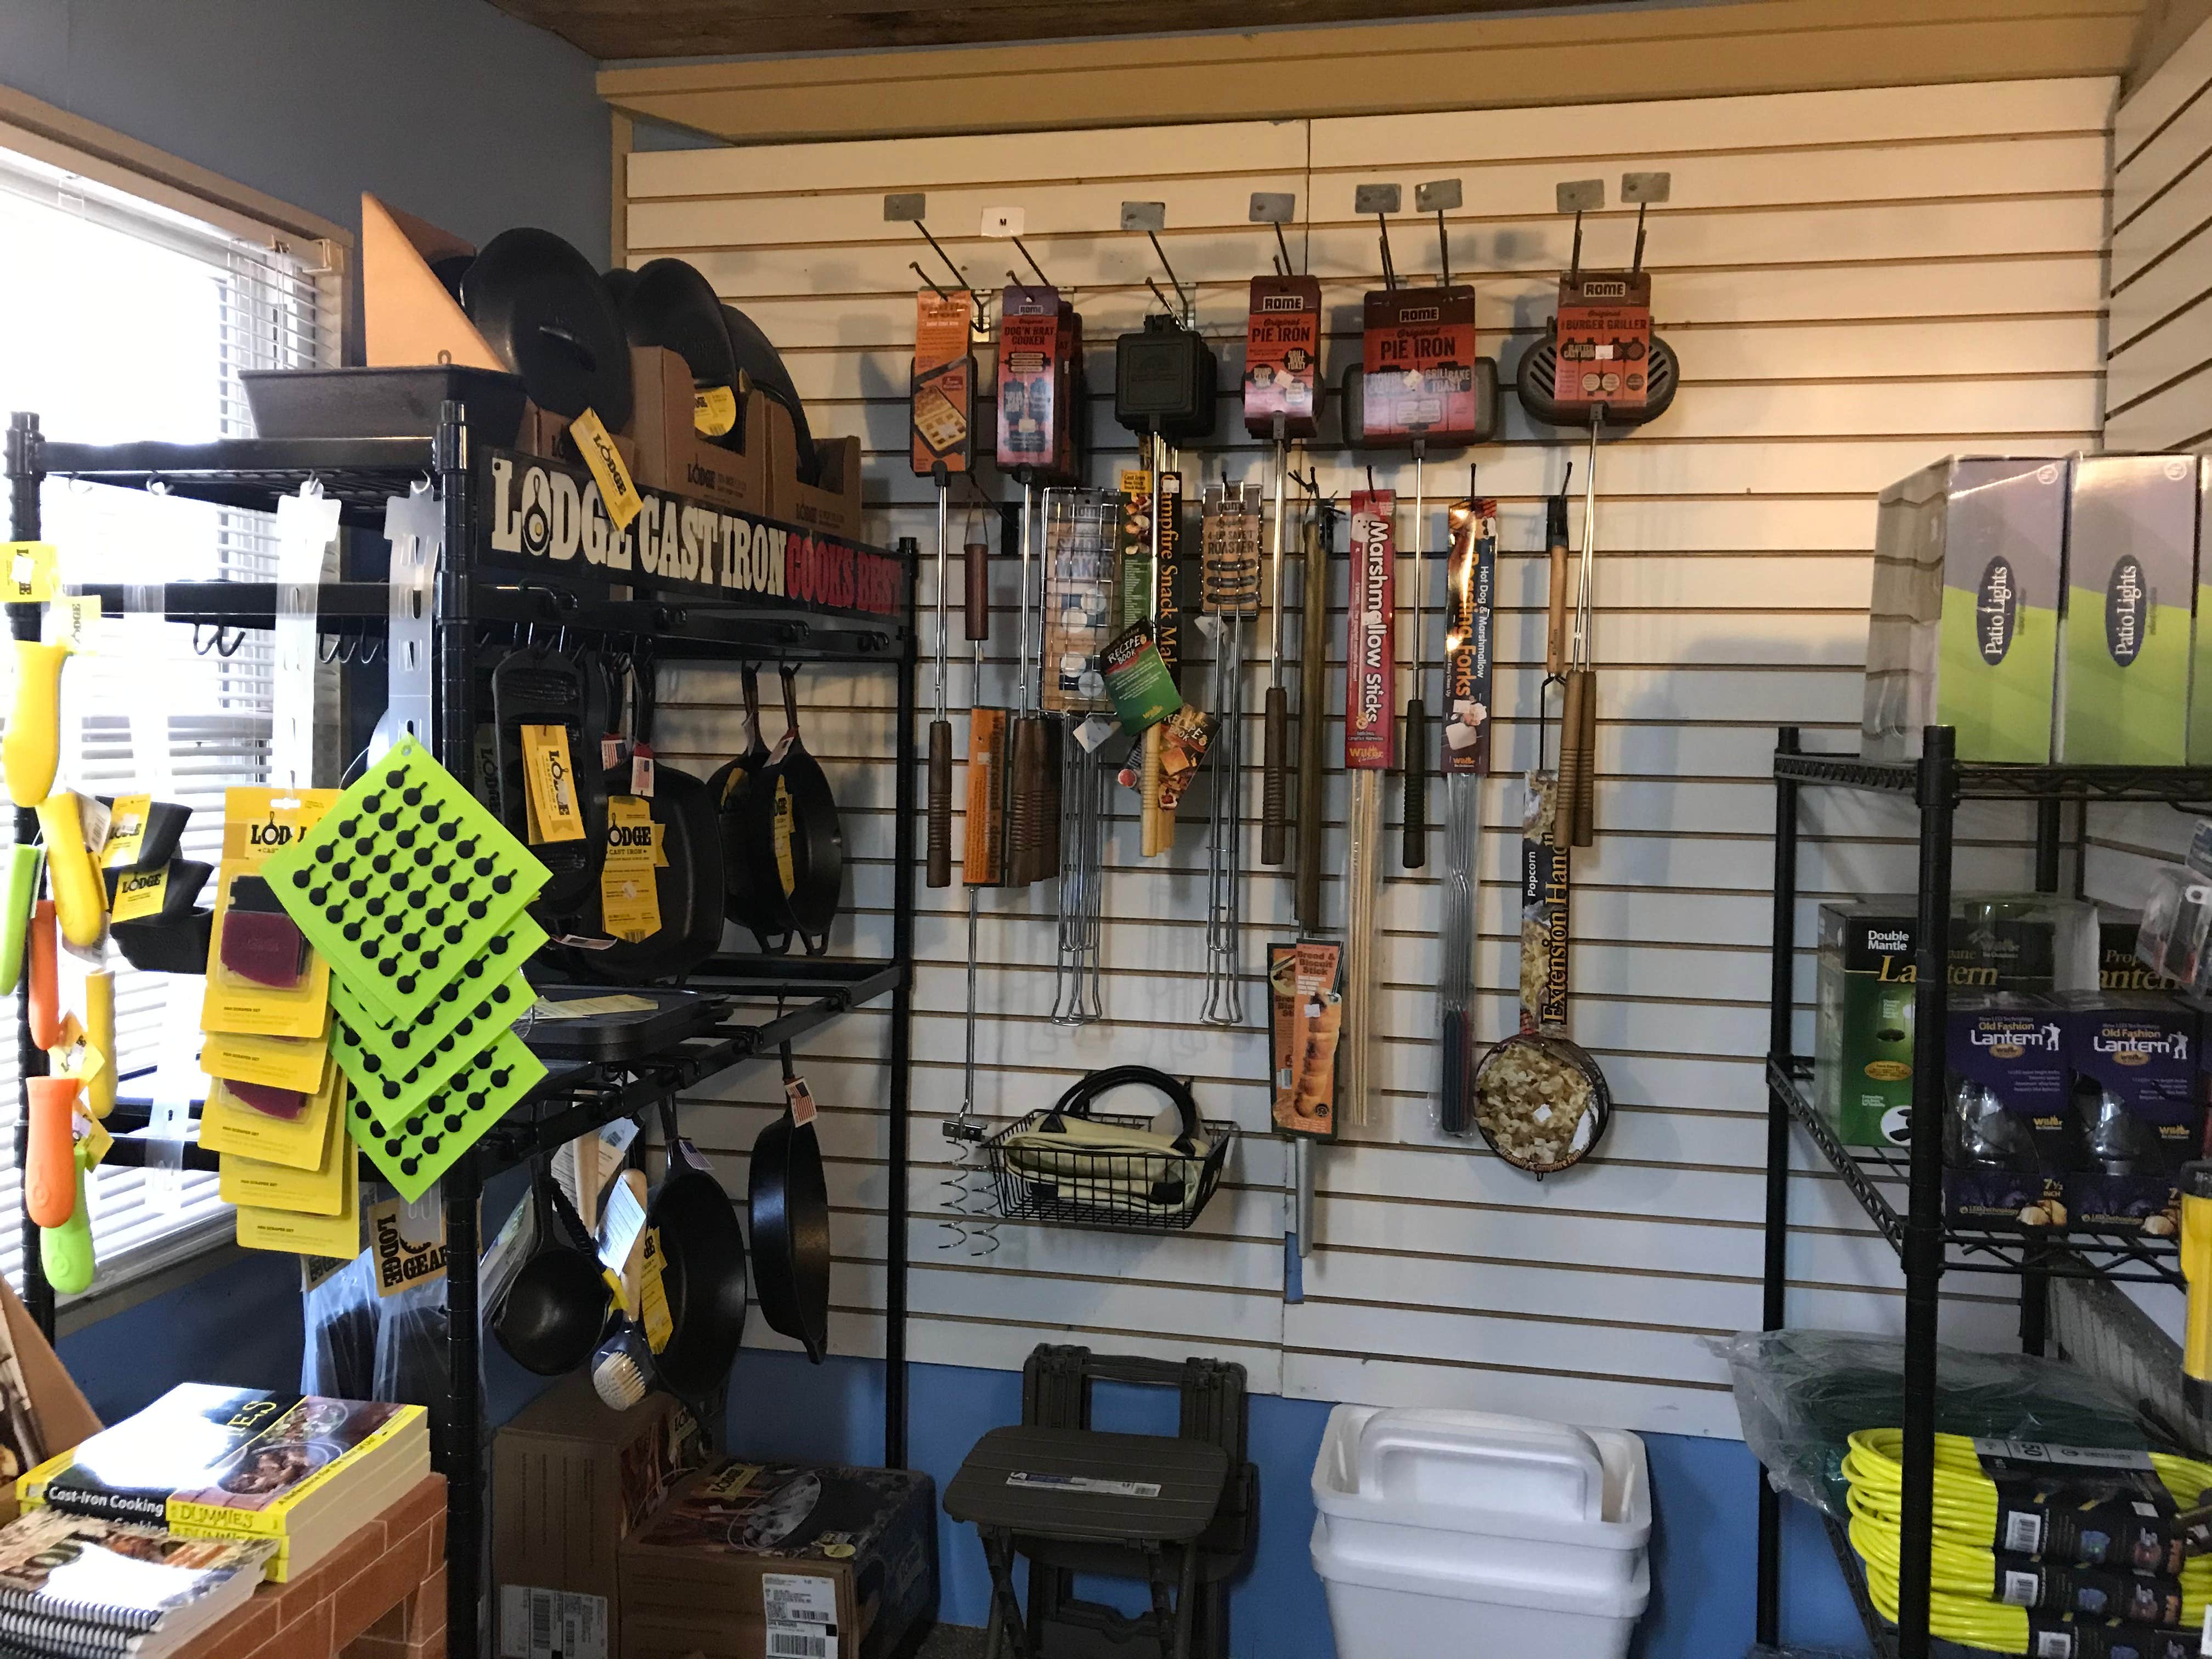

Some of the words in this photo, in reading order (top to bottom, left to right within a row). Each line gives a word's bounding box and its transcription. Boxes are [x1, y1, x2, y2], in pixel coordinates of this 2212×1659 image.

[1586, 284, 1624, 296] ROME
[1265, 298, 1301, 309] ROME
[1401, 309, 1438, 321] ROME
[1566, 320, 1604, 329] BURGER
[1607, 319, 1646, 329] GRILLER
[1012, 336, 1046, 345] COOKER
[1252, 328, 1275, 343] PIE
[1277, 327, 1311, 342] IRON
[1380, 340, 1409, 360] PIE
[1414, 337, 1456, 358] IRON
[1426, 368, 1448, 380] GRILL
[1448, 369, 1471, 383] BAKE
[1432, 380, 1461, 392] TOAST
[592, 433, 627, 496] LODGE
[492, 457, 633, 570] LODGE
[639, 494, 718, 584] CAST
[720, 513, 787, 597] IRON
[786, 531, 855, 610] COOKS
[855, 551, 904, 618] BEST
[1208, 540, 1255, 554] ROASTER
[1480, 566, 1489, 584] Hot
[1159, 565, 1179, 619] Snack
[1366, 521, 1389, 668] Marshmallow
[1477, 584, 1488, 604] Dog
[1987, 566, 2012, 613] Lights
[2116, 565, 2142, 613] Lights
[1984, 615, 2004, 656] Patio
[2115, 615, 2134, 656] Patio
[1107, 635, 1142, 664] RECIPE
[1117, 648, 1137, 665] BOOK
[1477, 614, 1488, 679] Marshmallow
[1455, 645, 1477, 696] Forks
[1365, 674, 1384, 723] Sticks
[548, 749, 571, 816] LOE
[608, 825, 652, 847] ODGE
[122, 872, 162, 894] LODGE
[1527, 851, 1537, 898] Popcorn
[1868, 930, 1909, 941] Double
[1868, 940, 1907, 951] Mantle
[1297, 950, 1325, 960] Bread
[1299, 958, 1334, 968] Biscuit
[1302, 966, 1329, 975] Stick
[1542, 909, 1568, 1024] Extension
[1979, 1022, 1996, 1031] Old
[1998, 1022, 2035, 1031] Fashion
[2102, 1029, 2120, 1037] Old
[2122, 1029, 2161, 1038] Fashion
[1970, 1029, 2044, 1046] Lantern
[2094, 1036, 2170, 1053] Lantern
[377, 1213, 404, 1288] LODGE
[48, 1486, 108, 1507] Cast-Iron
[109, 1494, 165, 1519] Cooking
[179, 1503, 256, 1529] DUMMIES
